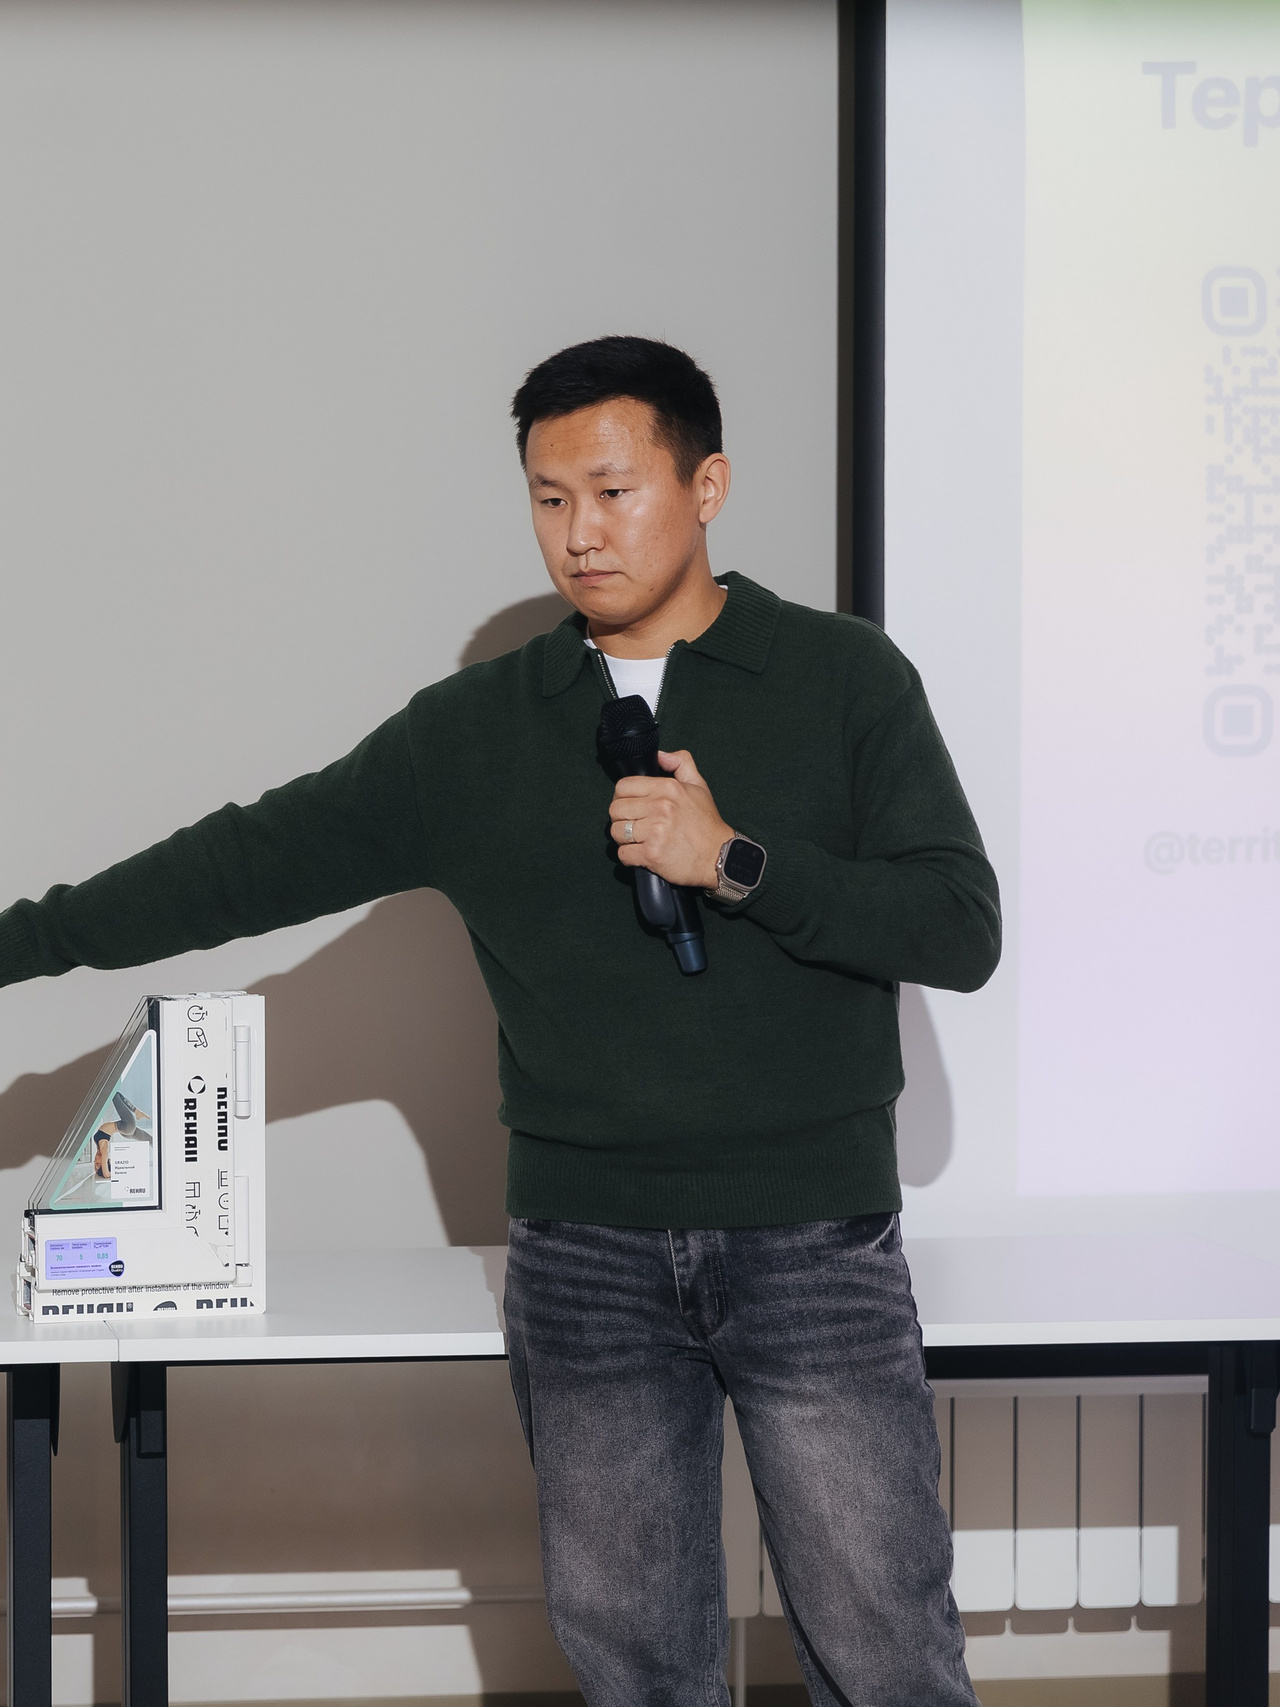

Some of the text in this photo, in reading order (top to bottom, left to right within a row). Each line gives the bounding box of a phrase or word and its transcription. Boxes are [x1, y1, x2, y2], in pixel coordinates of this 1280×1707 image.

[52, 1281, 230, 1297] Remove protective foil after installation of the window
